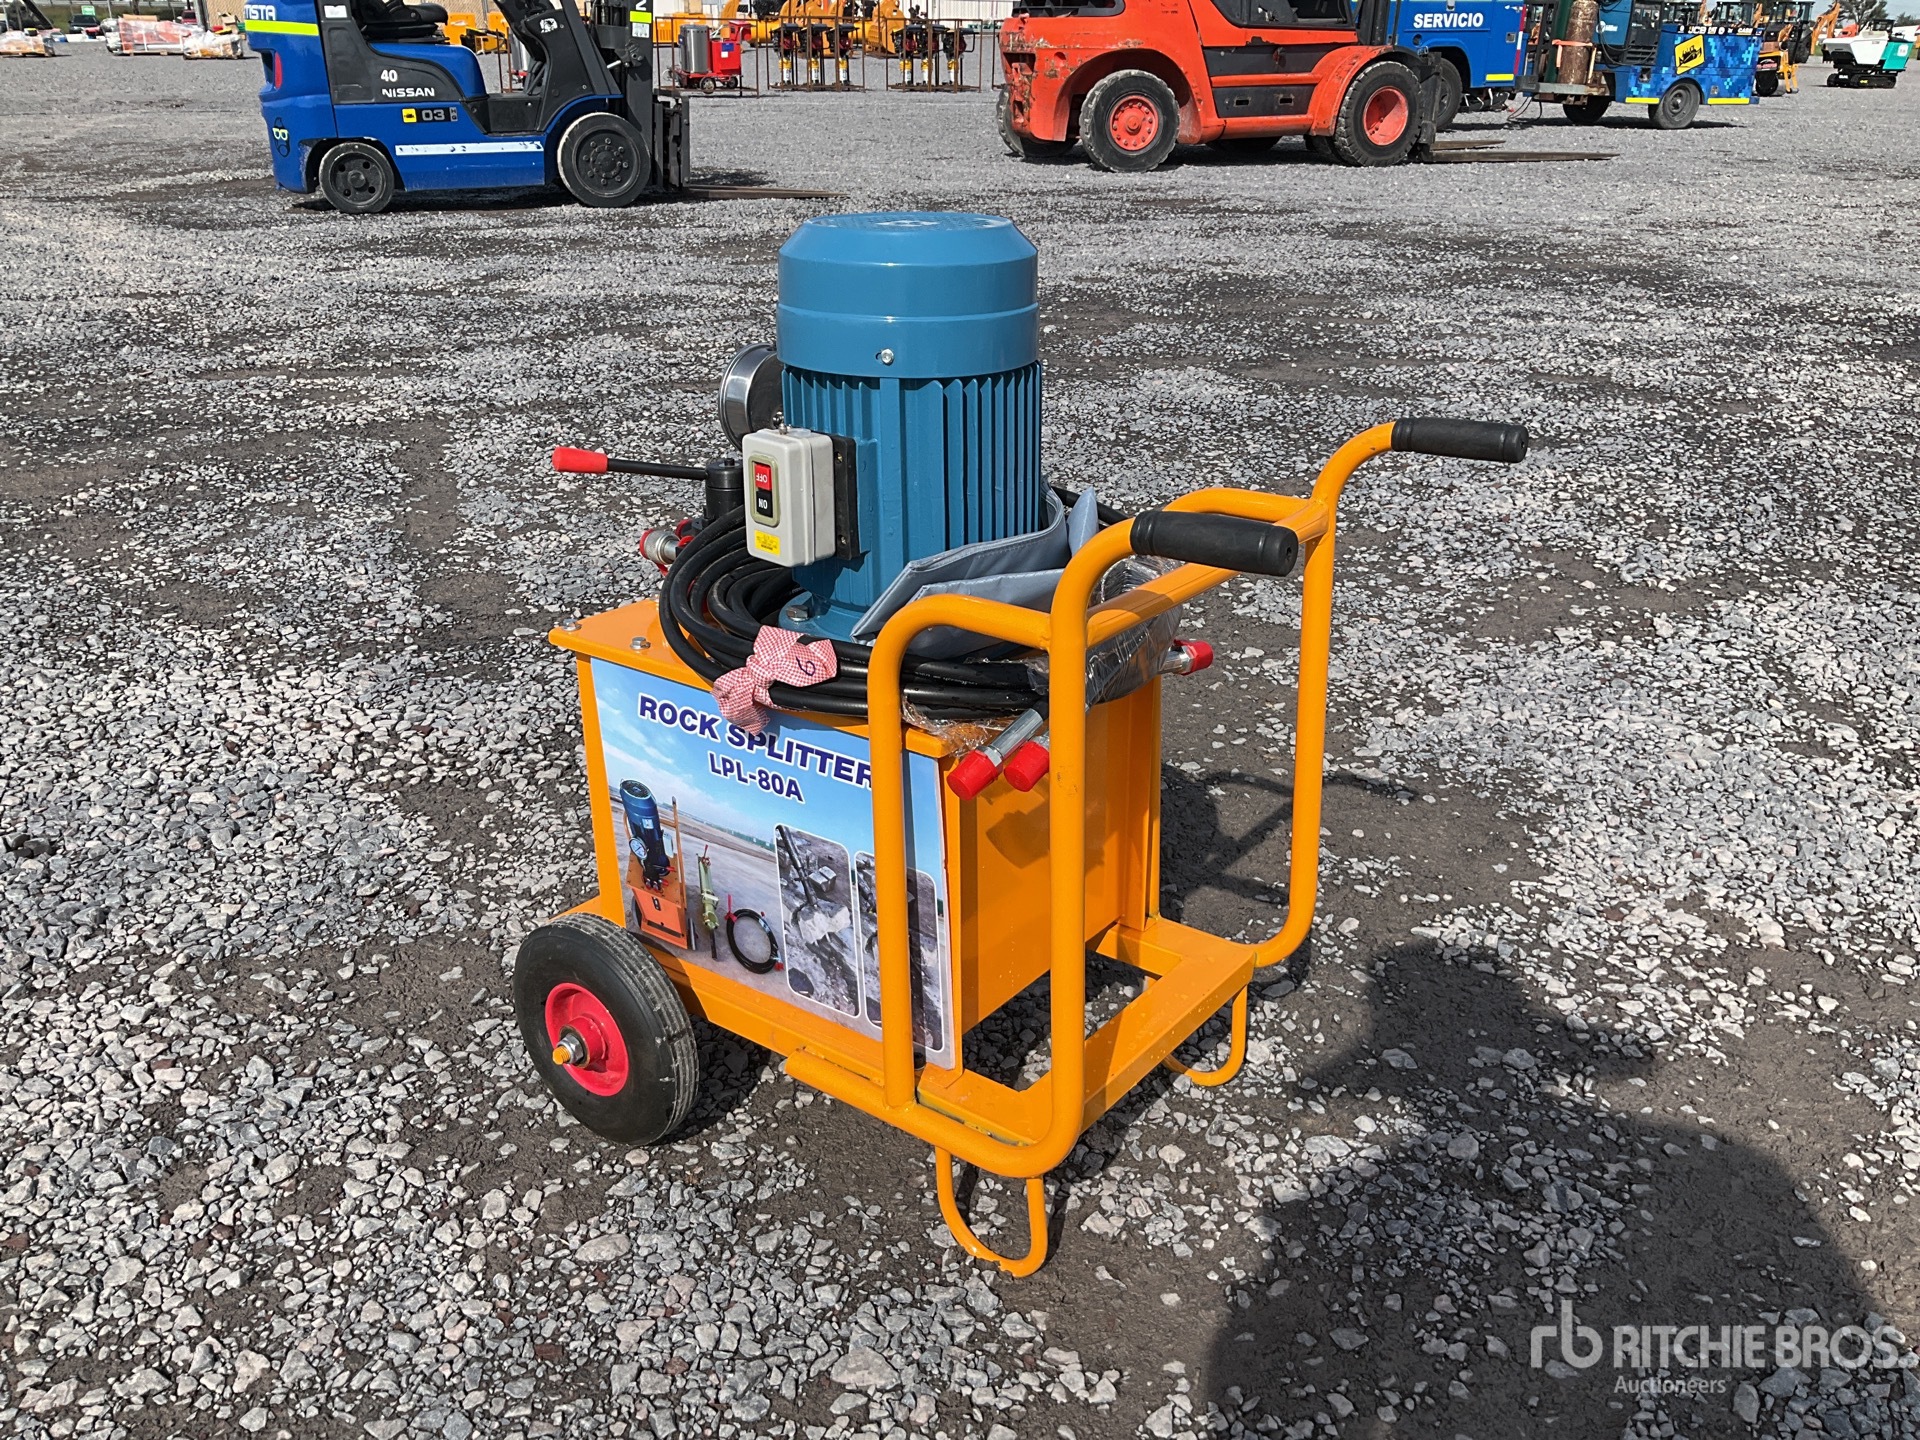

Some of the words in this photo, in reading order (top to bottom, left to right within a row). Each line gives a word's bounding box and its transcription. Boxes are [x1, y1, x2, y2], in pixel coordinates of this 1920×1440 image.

[1413, 12, 1484, 29] SERVICIO
[380, 69, 398, 82] 40
[381, 87, 435, 98] NISSAN
[421, 109, 446, 121] 03
[755, 472, 768, 483] OFF
[758, 498, 768, 509] ON
[639, 695, 721, 740] ROCK
[709, 752, 804, 802] LPL-80A
